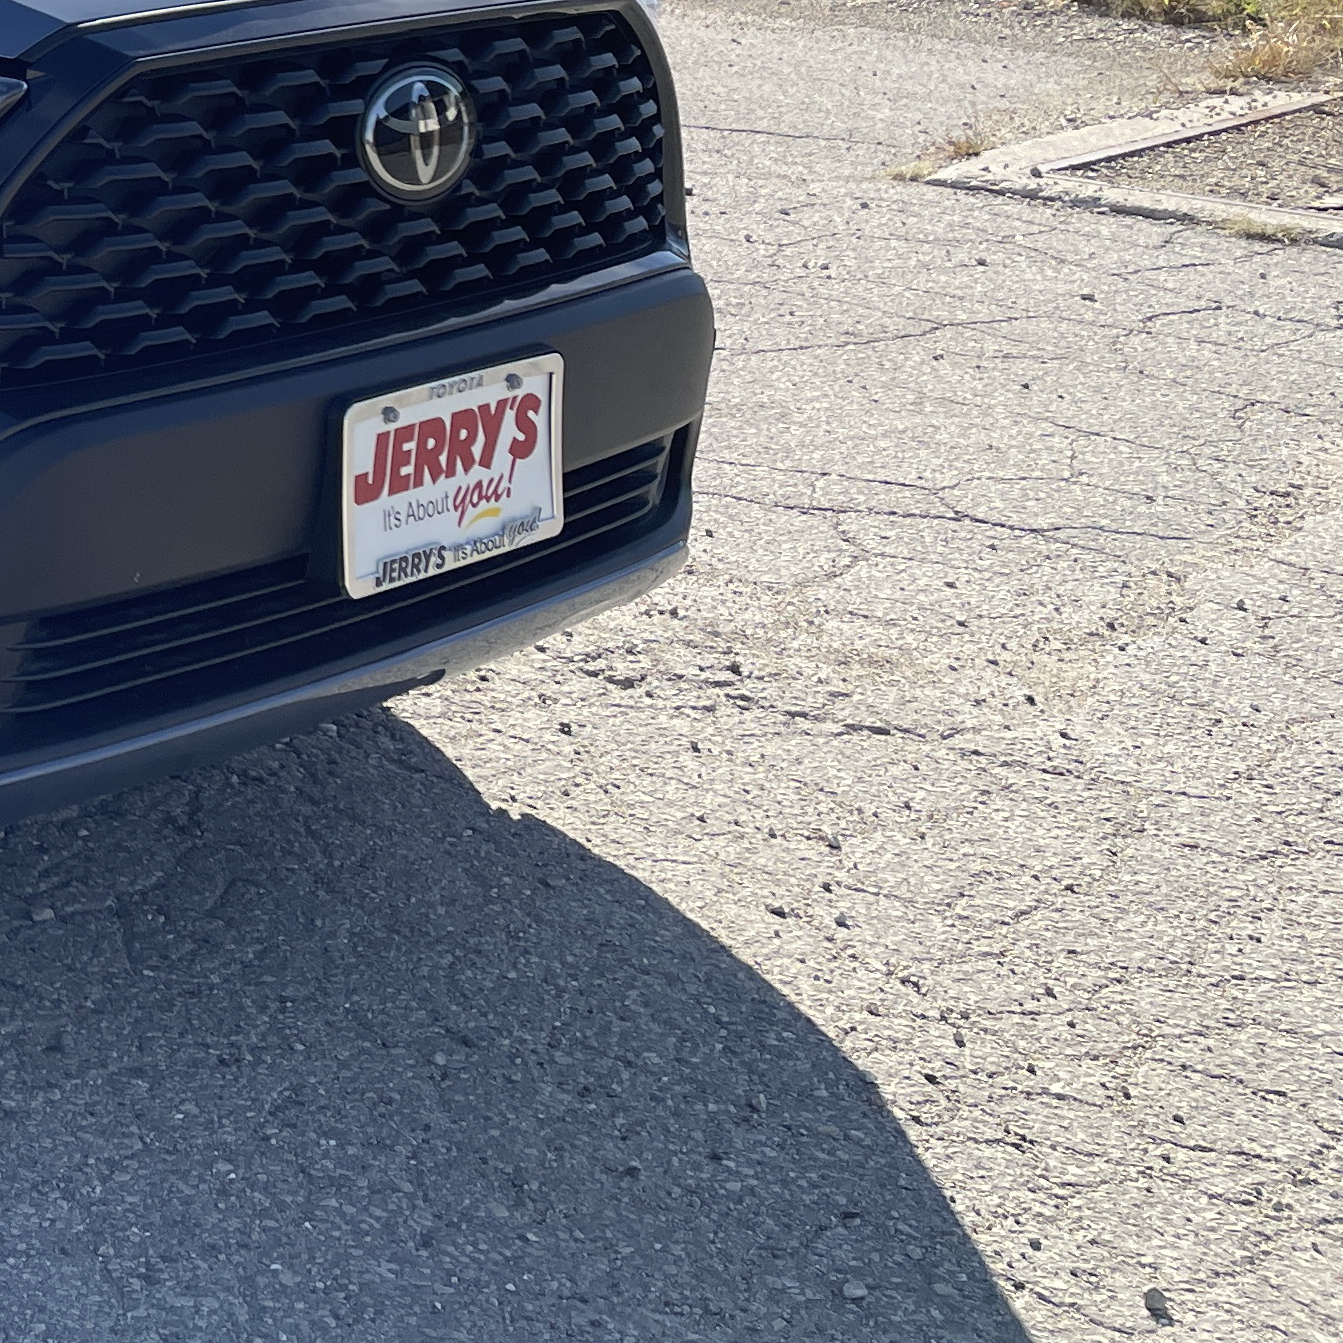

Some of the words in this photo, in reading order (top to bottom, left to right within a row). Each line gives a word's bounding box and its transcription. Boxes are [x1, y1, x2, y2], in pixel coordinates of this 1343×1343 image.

[428, 374, 484, 399] TOYOTA
[354, 392, 542, 506] JERRY'S
[383, 505, 402, 532] It's
[405, 490, 451, 526] About
[453, 457, 517, 529] you!
[375, 544, 447, 588] JERRY'S
[469, 529, 506, 558] About
